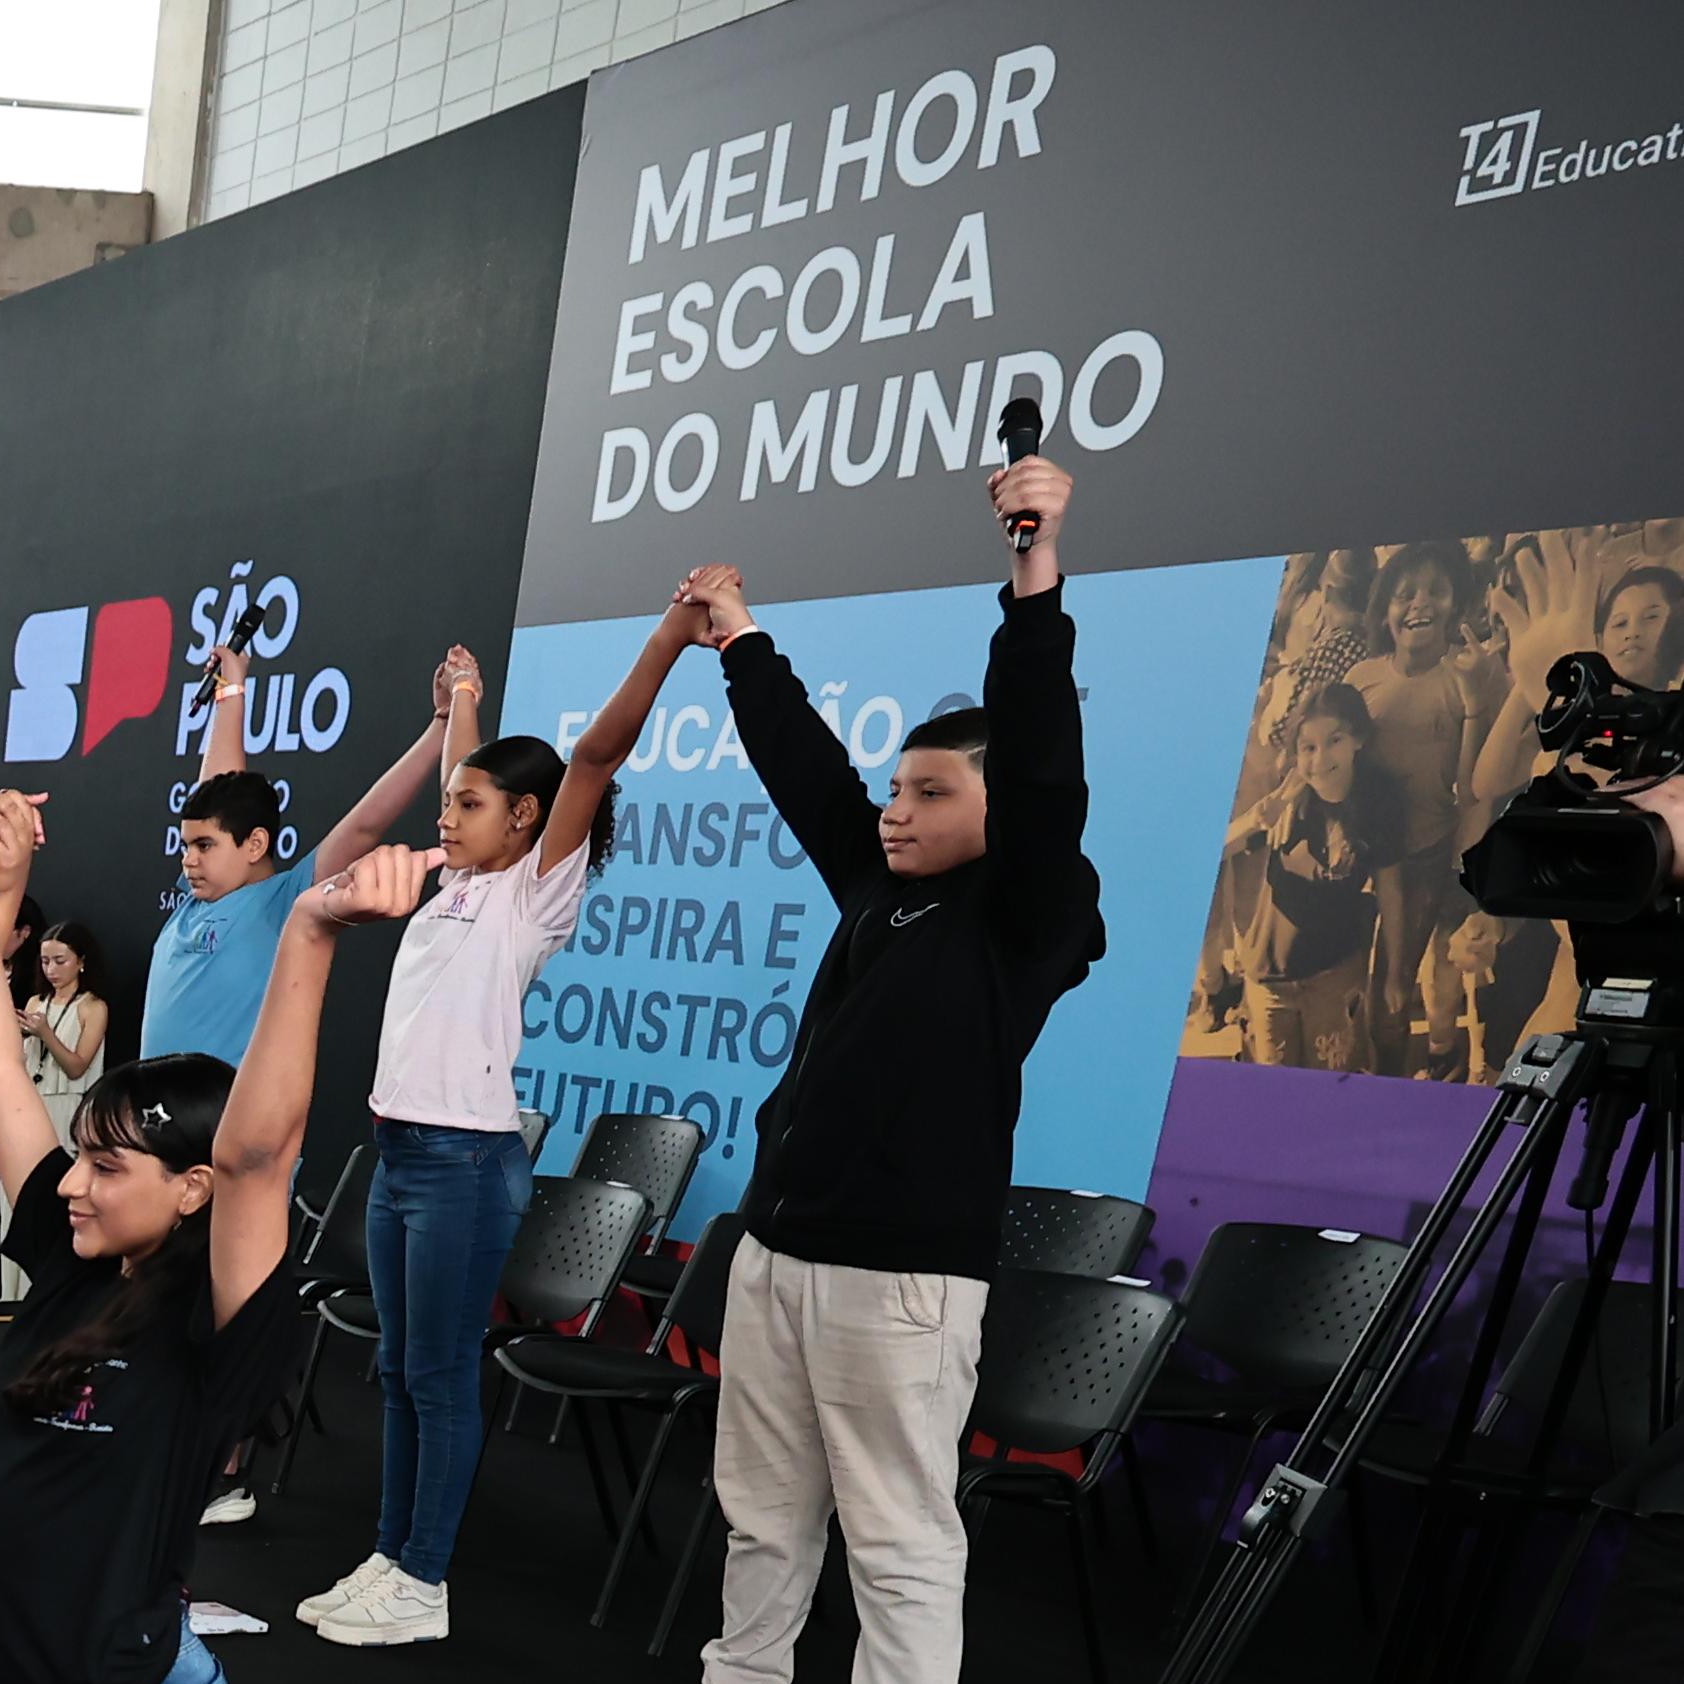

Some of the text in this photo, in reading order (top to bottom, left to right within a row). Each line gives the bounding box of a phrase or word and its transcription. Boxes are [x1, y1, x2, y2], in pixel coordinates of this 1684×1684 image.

[629, 45, 1056, 264] MELHOR
[1531, 122, 1684, 190] Educat
[610, 211, 994, 395] ESCOLA
[591, 330, 1164, 523] DO MUNDO
[185, 559, 299, 666] SÃO
[176, 667, 351, 756] PULO
[563, 894, 806, 970] SPIRA E
[521, 980, 797, 1068] CONSTRÓ
